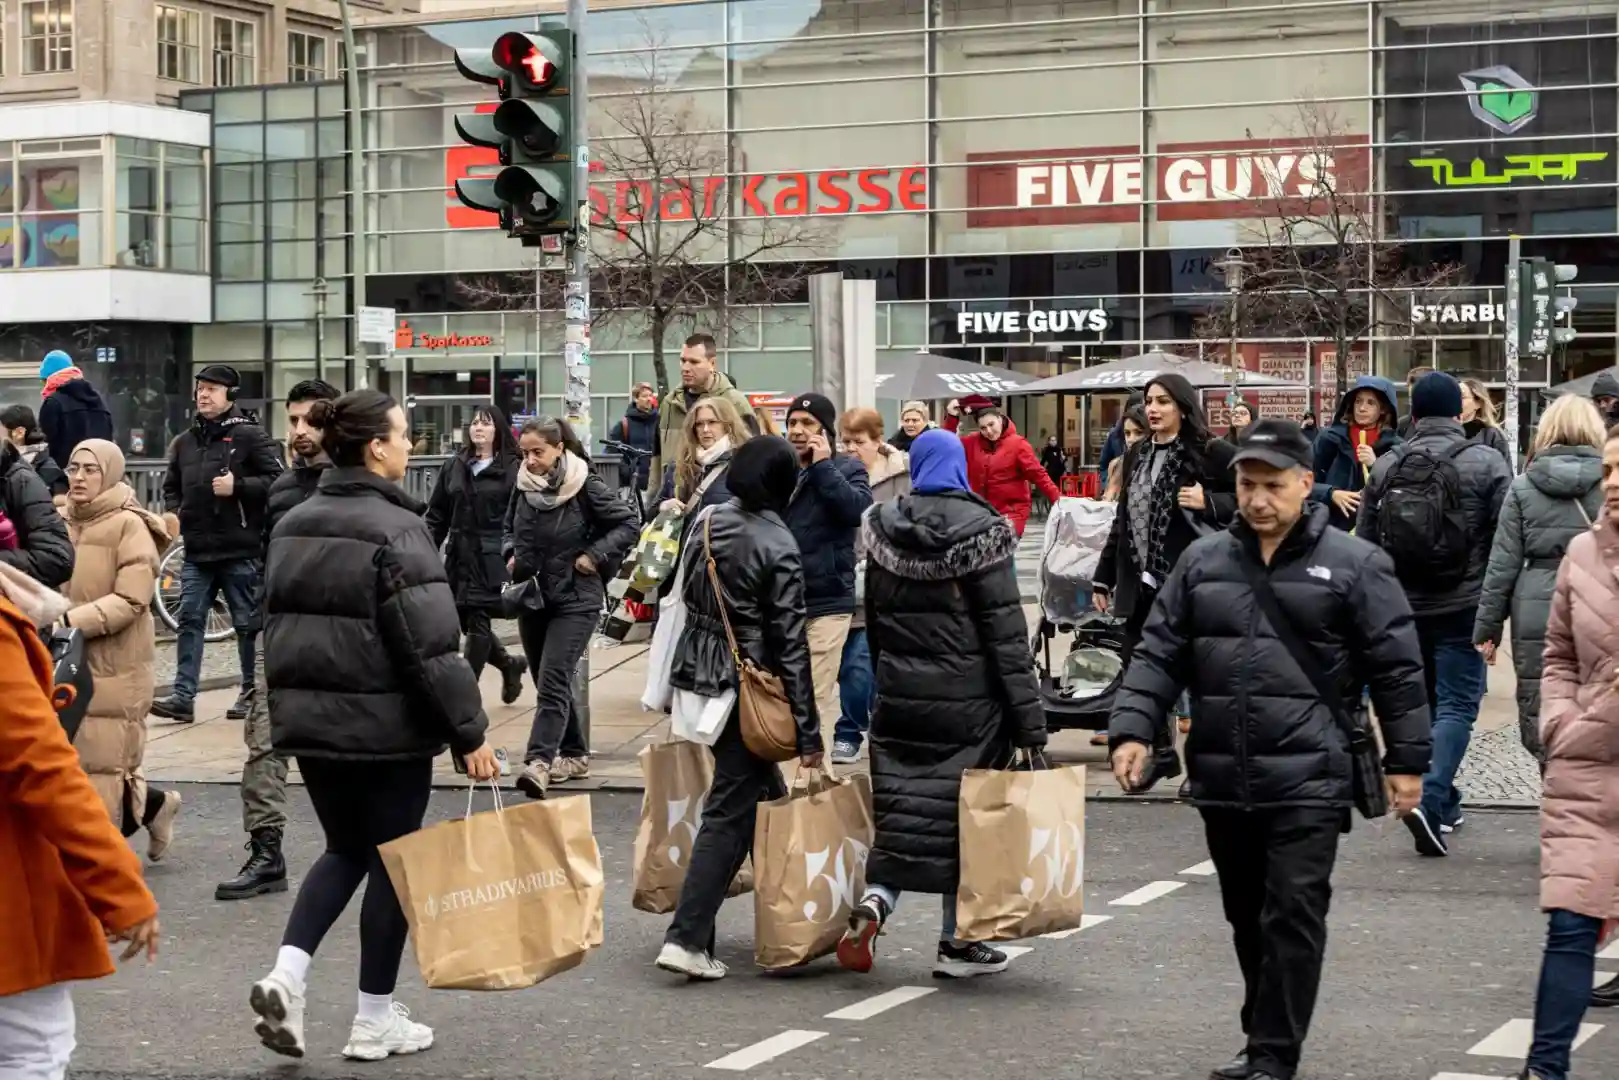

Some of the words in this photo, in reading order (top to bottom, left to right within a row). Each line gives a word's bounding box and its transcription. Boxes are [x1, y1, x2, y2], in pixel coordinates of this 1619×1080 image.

[1016, 157, 1141, 208] FIVE
[1164, 151, 1338, 202] GUYS
[957, 311, 1020, 333] FIVE
[1027, 308, 1108, 332] GUYS
[419, 332, 492, 350] Sparkasse
[1261, 359, 1305, 369] QUALITY
[936, 371, 1002, 384] FIVE
[440, 867, 567, 912] STRADIVARIUS
